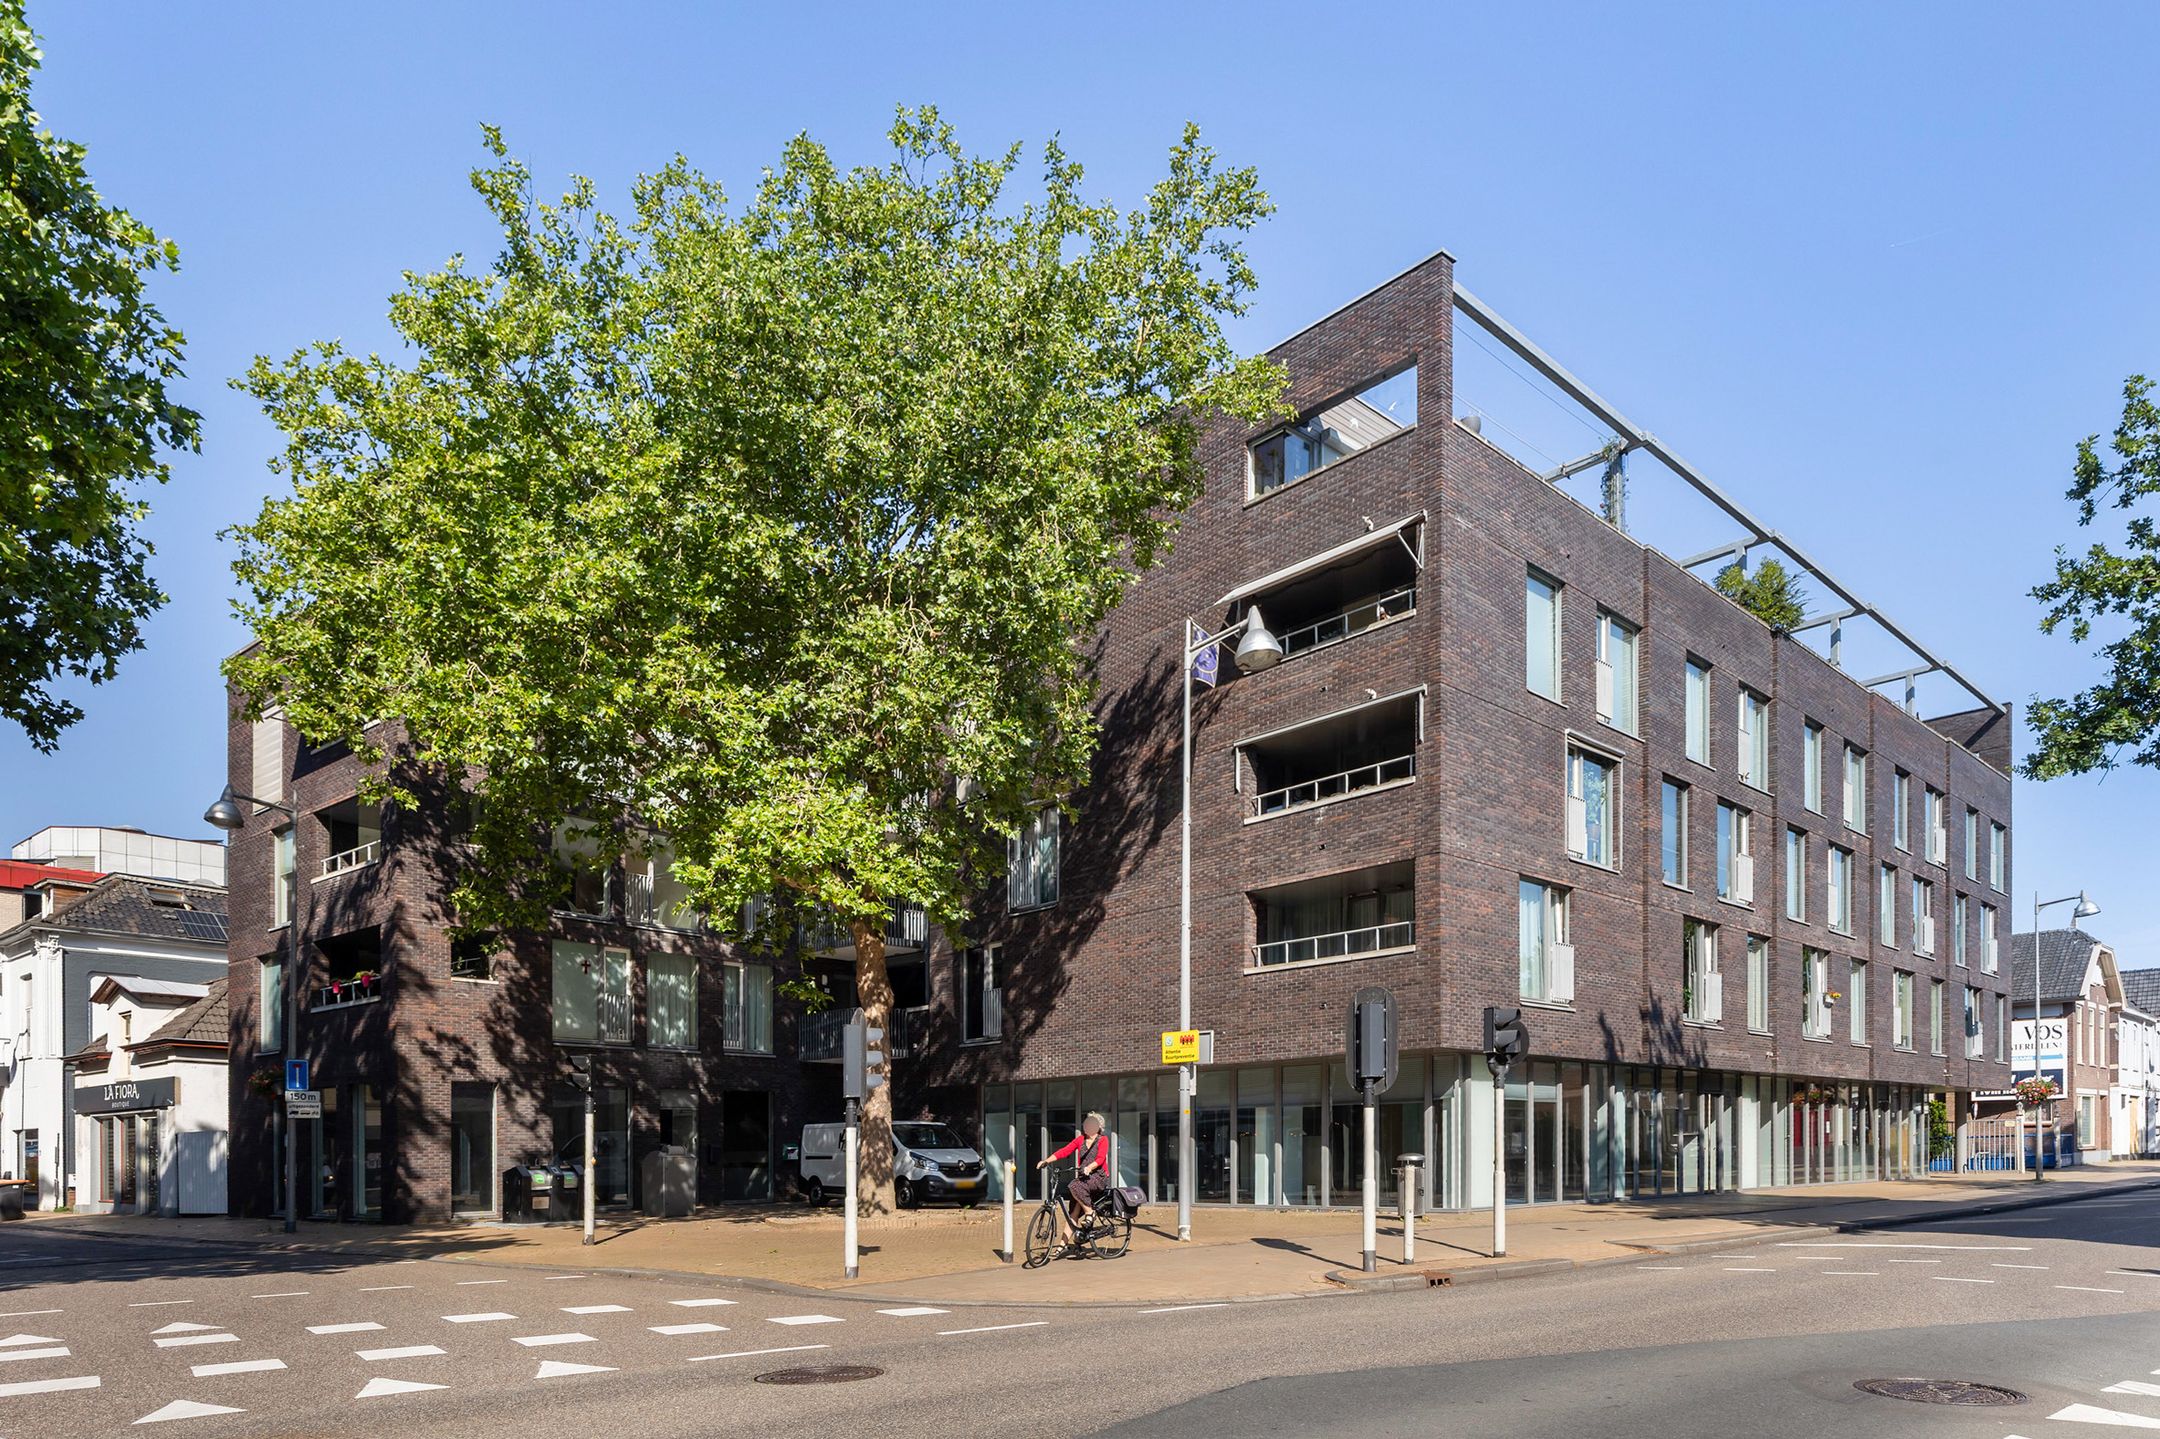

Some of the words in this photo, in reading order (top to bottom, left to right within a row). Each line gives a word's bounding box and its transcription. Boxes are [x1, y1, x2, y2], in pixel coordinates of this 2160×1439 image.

[2024, 1024, 2063, 1041] VOS
[104, 1084, 114, 1101] LA
[115, 1083, 140, 1100] FIORA
[290, 1092, 307, 1101] 150
[111, 1100, 130, 1109] BOUTIQUE
